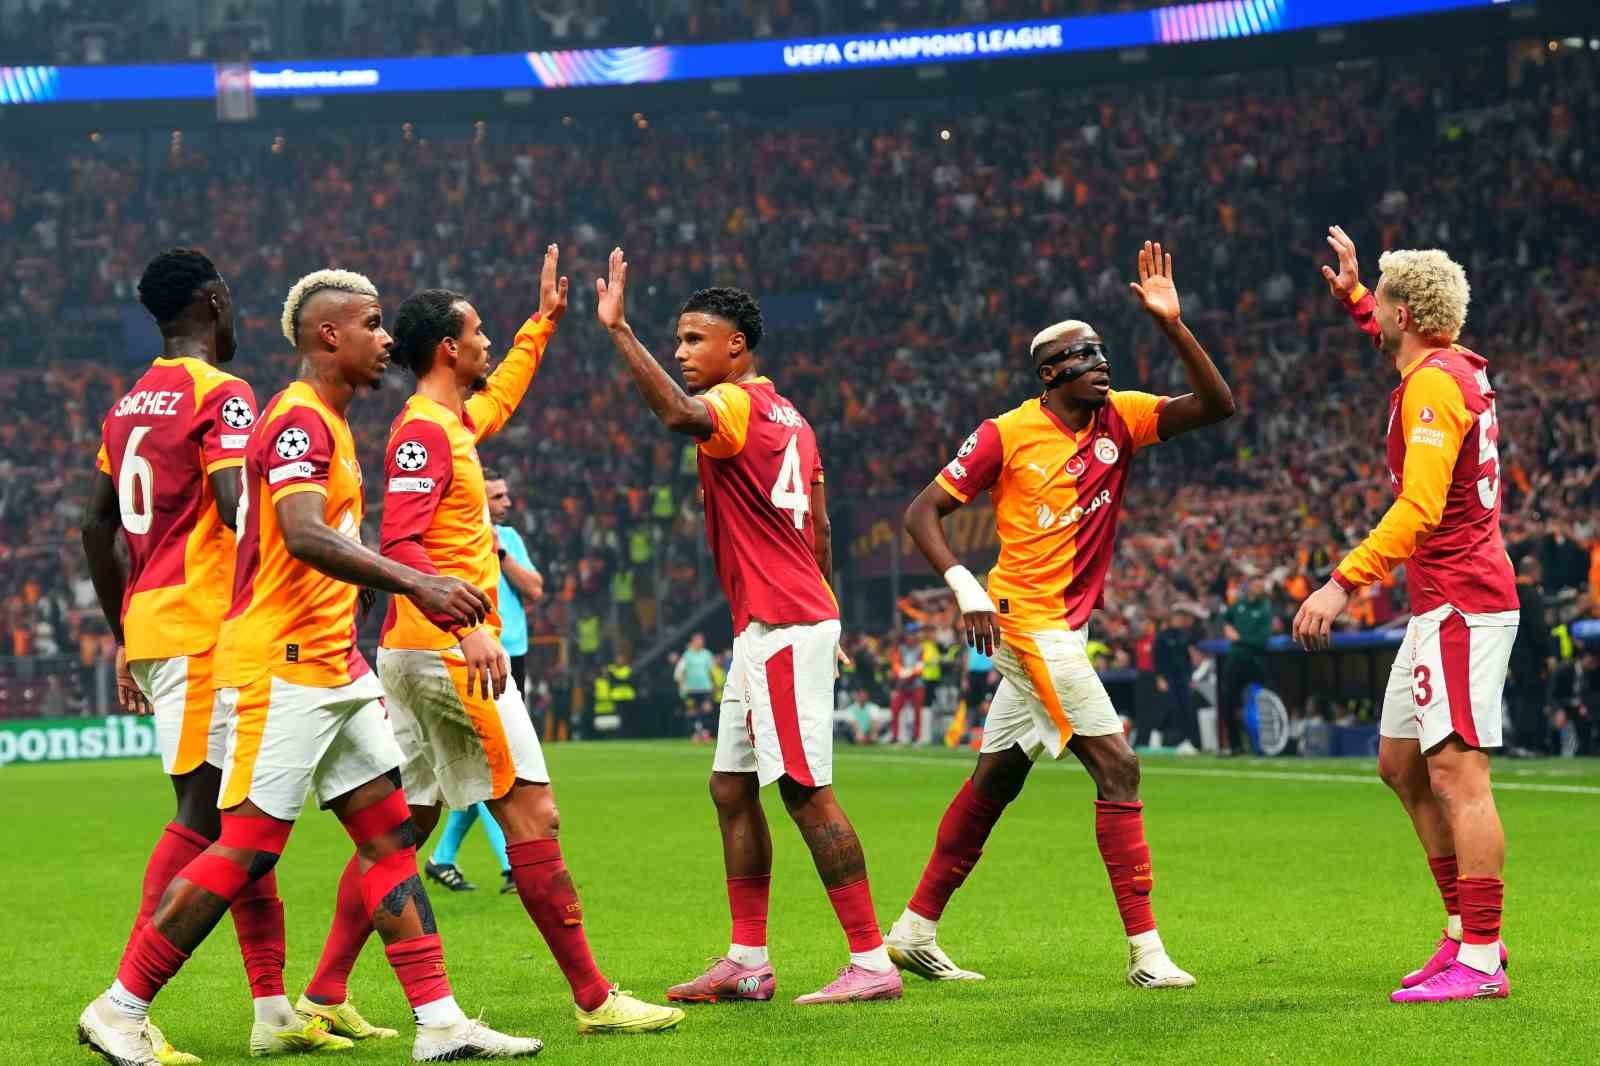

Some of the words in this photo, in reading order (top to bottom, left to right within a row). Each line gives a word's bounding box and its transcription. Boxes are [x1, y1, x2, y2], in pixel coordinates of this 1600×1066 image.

[783, 43, 842, 67] UEFA
[843, 31, 976, 63] CHAMPIONS
[976, 24, 1064, 53] LEAGUE
[118, 426, 153, 535] 6
[771, 433, 810, 530] 4
[1059, 489, 1112, 528] SOAR
